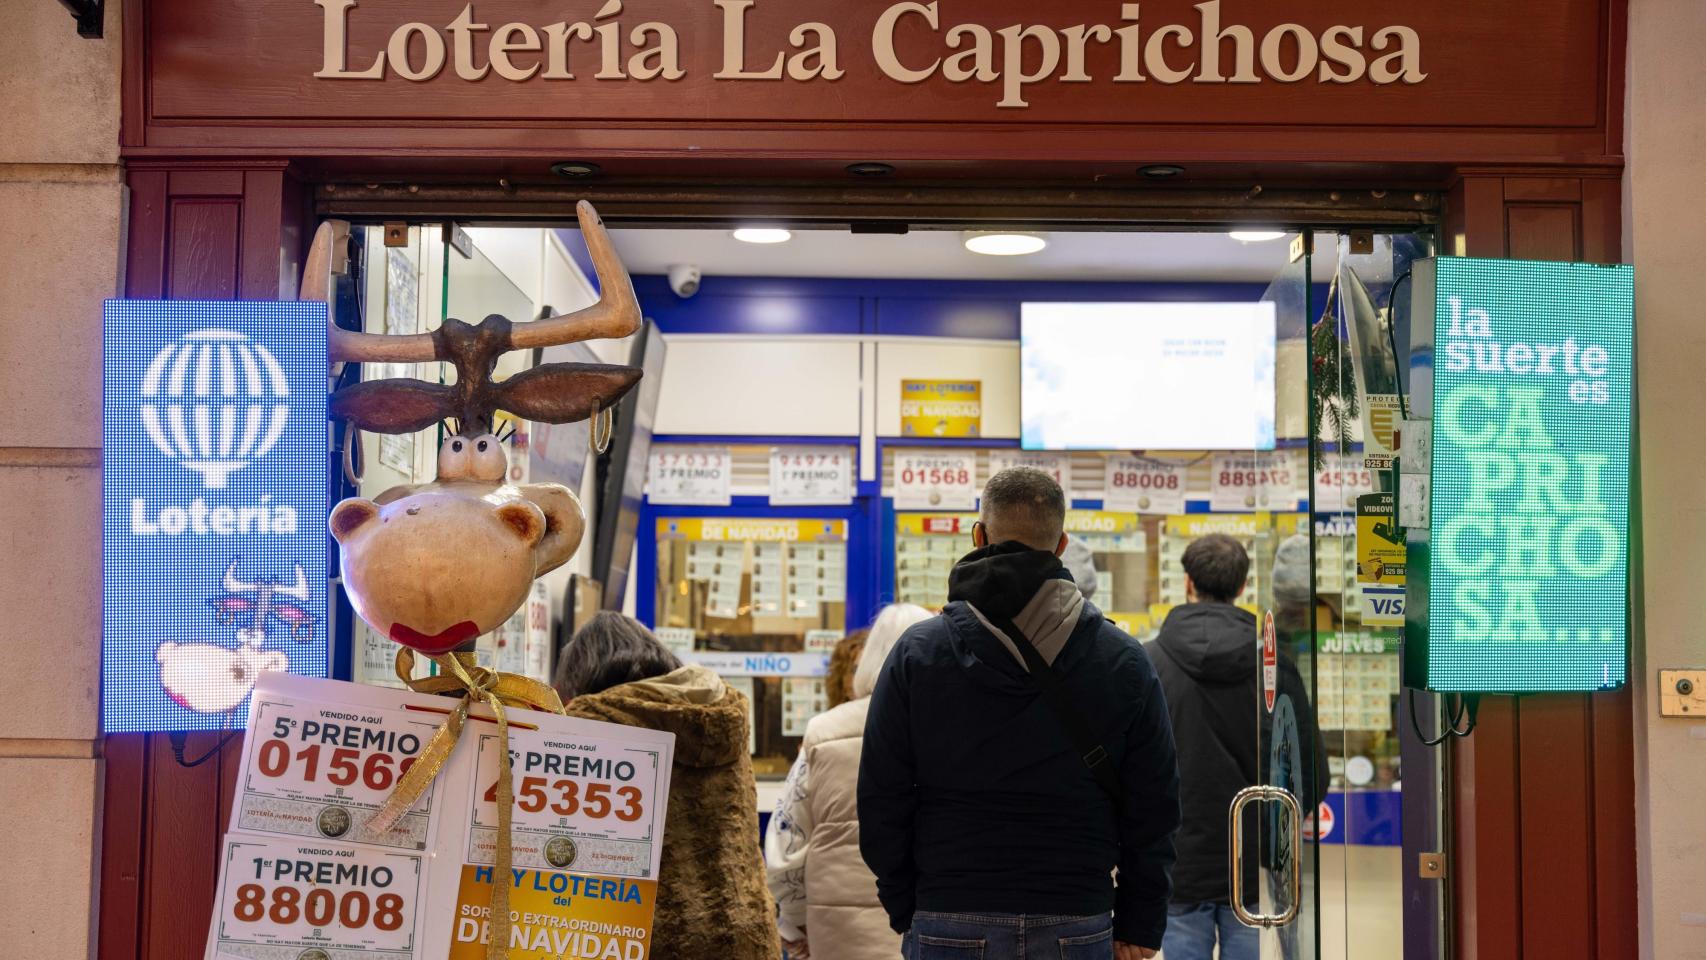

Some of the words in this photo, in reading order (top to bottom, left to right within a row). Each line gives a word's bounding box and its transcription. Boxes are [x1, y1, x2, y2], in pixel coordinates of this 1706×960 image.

[314, 0, 686, 82] Lotería
[713, 0, 845, 82] La
[871, 0, 1428, 108] Caprichosa
[1447, 296, 1492, 337] la
[1445, 335, 1609, 376] suerte
[1568, 377, 1610, 404] es
[1439, 383, 1555, 448] CA
[917, 459, 964, 468] PREMIO
[1365, 460, 1381, 468] 925
[671, 469, 721, 479] PREMIO
[792, 470, 839, 480] PREMIO
[902, 469, 969, 485] 01568
[1113, 471, 1178, 490] 88008
[1319, 472, 1371, 488] 4535
[1464, 451, 1609, 514] PRI
[131, 494, 298, 536] Lotería
[1364, 505, 1393, 513] VIDEOVI
[1437, 514, 1621, 578] CHO
[1369, 598, 1406, 615] VIS
[745, 653, 791, 672] NIÑO
[319, 710, 359, 722] VENDIDO
[360, 715, 382, 725] AQUÍ
[301, 721, 420, 755] PREMIO
[543, 741, 576, 750] VENDIDO
[578, 744, 597, 752] AQUÍ
[525, 751, 636, 781] PREMIO
[247, 810, 274, 818] LOTERÍA
[282, 814, 313, 823] NAVIDAD
[298, 847, 333, 857] VENDIDO
[335, 849, 355, 858] AQUÍ
[477, 843, 497, 851] LOTER
[512, 846, 539, 854] AVIDAD
[274, 859, 393, 888] PREMIO
[475, 865, 523, 888] HY
[533, 870, 642, 905] LOTERÍA
[233, 883, 404, 931] 88008
[553, 895, 571, 907] del
[461, 904, 520, 923] SORO
[523, 912, 646, 940] EXTRAORDINARIO
[509, 924, 645, 960] NAVIDAD
